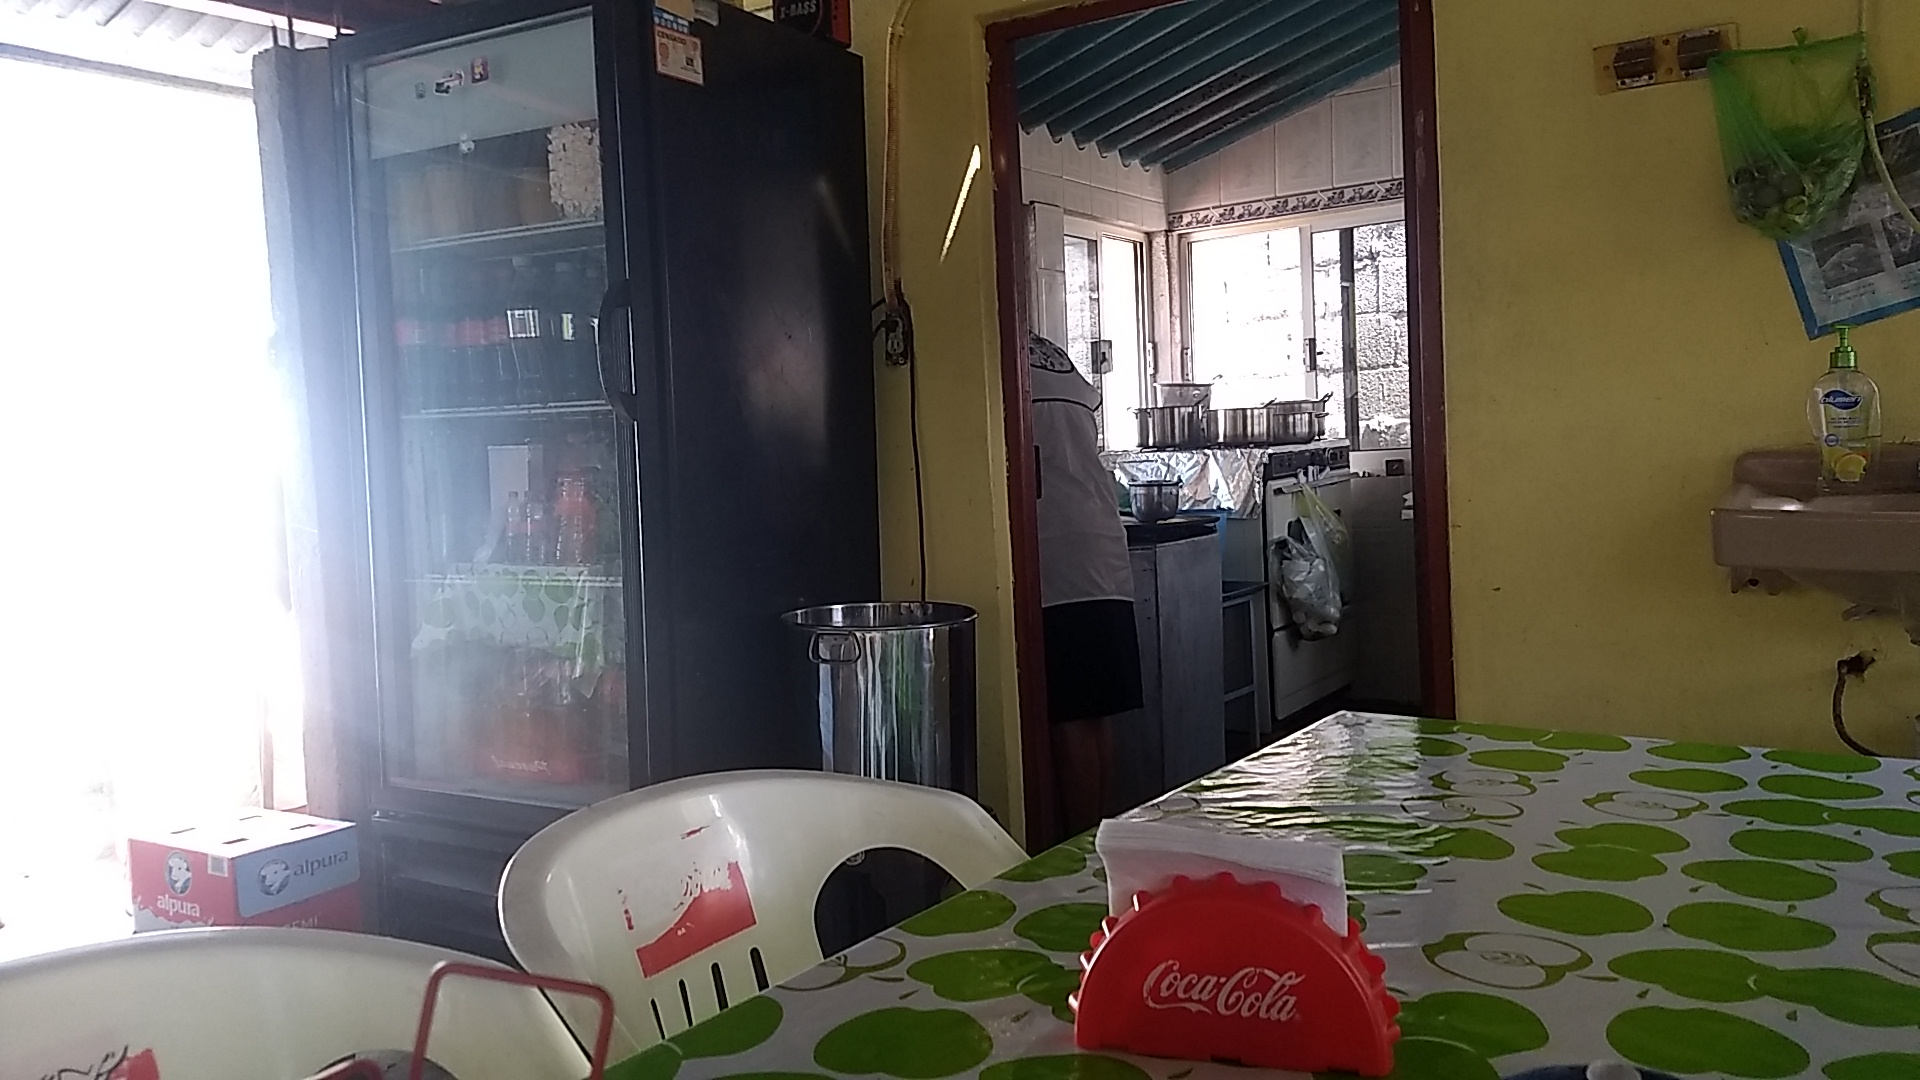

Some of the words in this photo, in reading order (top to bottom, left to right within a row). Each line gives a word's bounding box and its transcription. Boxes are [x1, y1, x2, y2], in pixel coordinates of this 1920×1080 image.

[293, 850, 349, 877] alpura
[157, 893, 201, 918] alpura
[284, 915, 319, 928] EMI
[1143, 959, 1306, 1022] Coca-Cola
